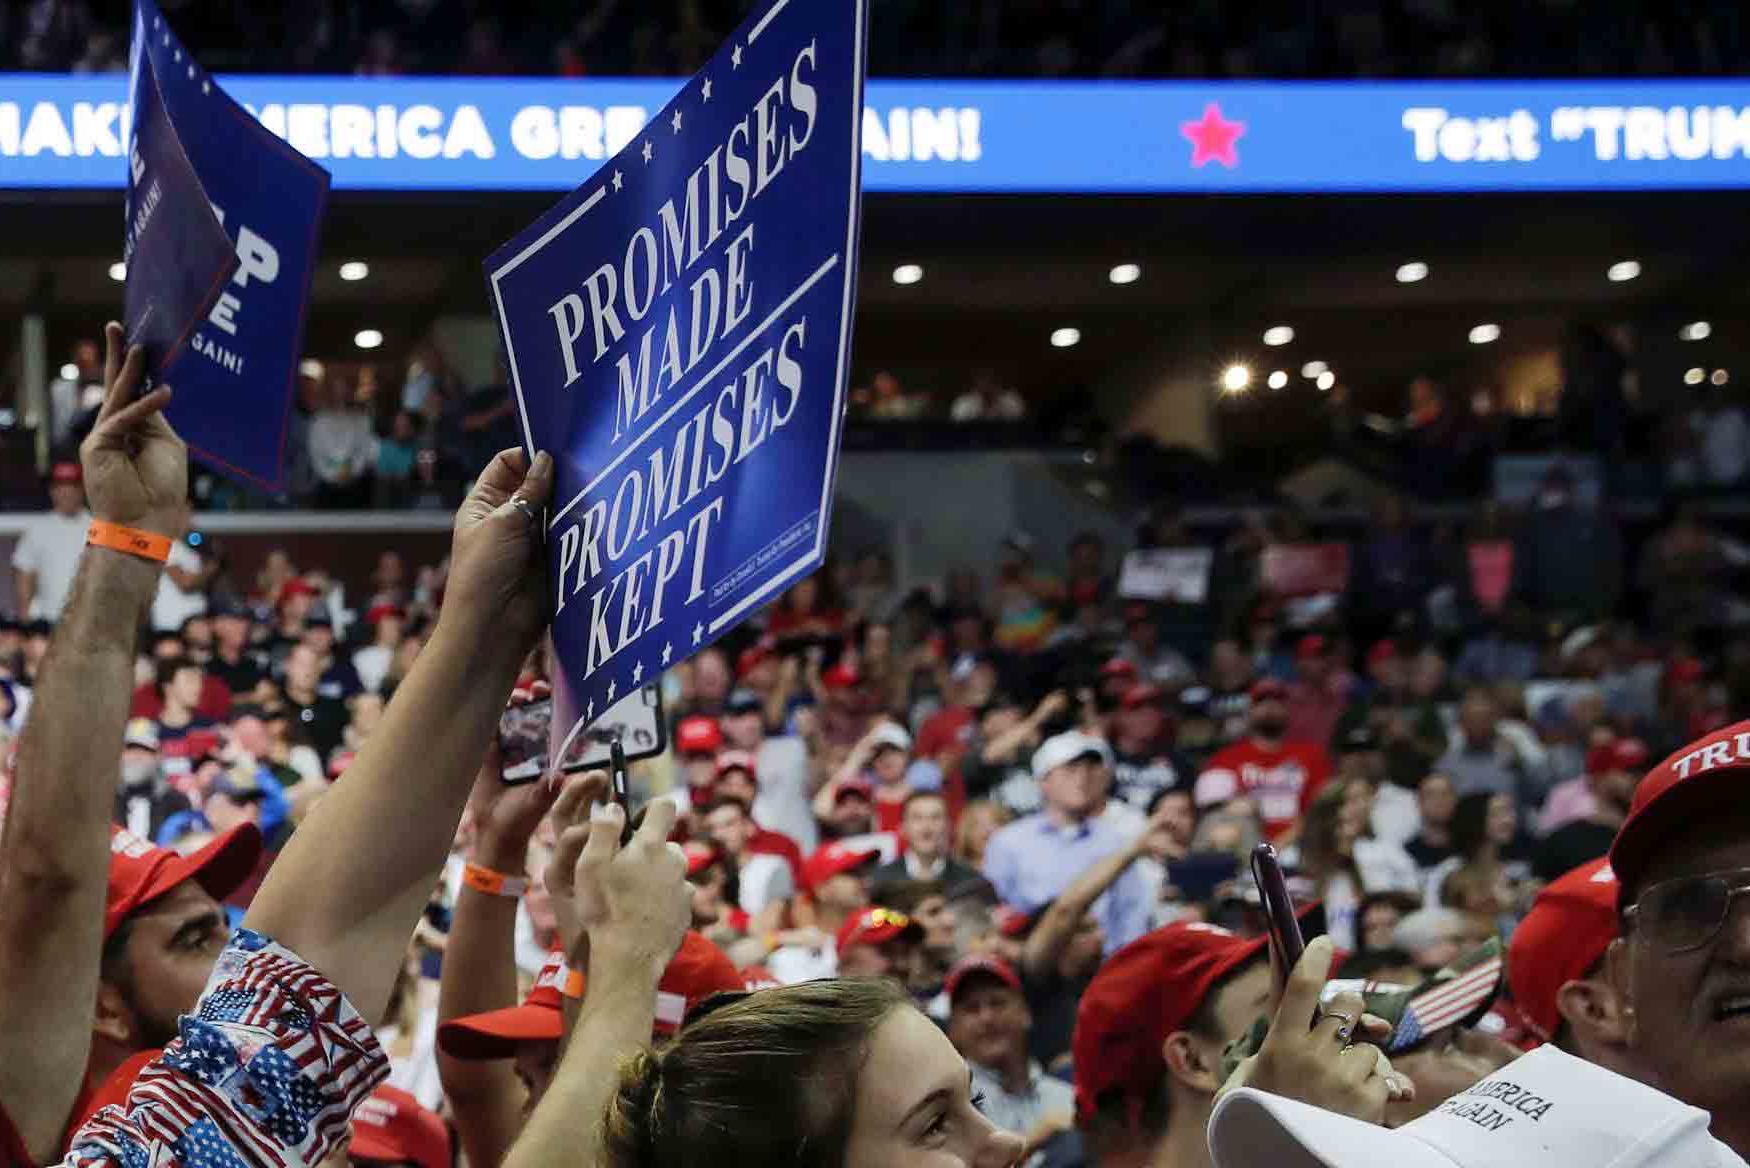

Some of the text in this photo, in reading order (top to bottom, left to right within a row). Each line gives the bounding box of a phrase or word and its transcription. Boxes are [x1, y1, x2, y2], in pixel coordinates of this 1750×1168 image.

[243, 104, 495, 158] ERICA
[511, 106, 647, 160] GRE
[862, 107, 982, 161] AIN!
[548, 38, 817, 388] PROMISES
[1401, 107, 1539, 161] Text
[191, 333, 243, 375] GAIN!
[611, 223, 753, 444] MADE
[555, 316, 806, 615] PROMISES
[583, 496, 723, 680] KEPT
